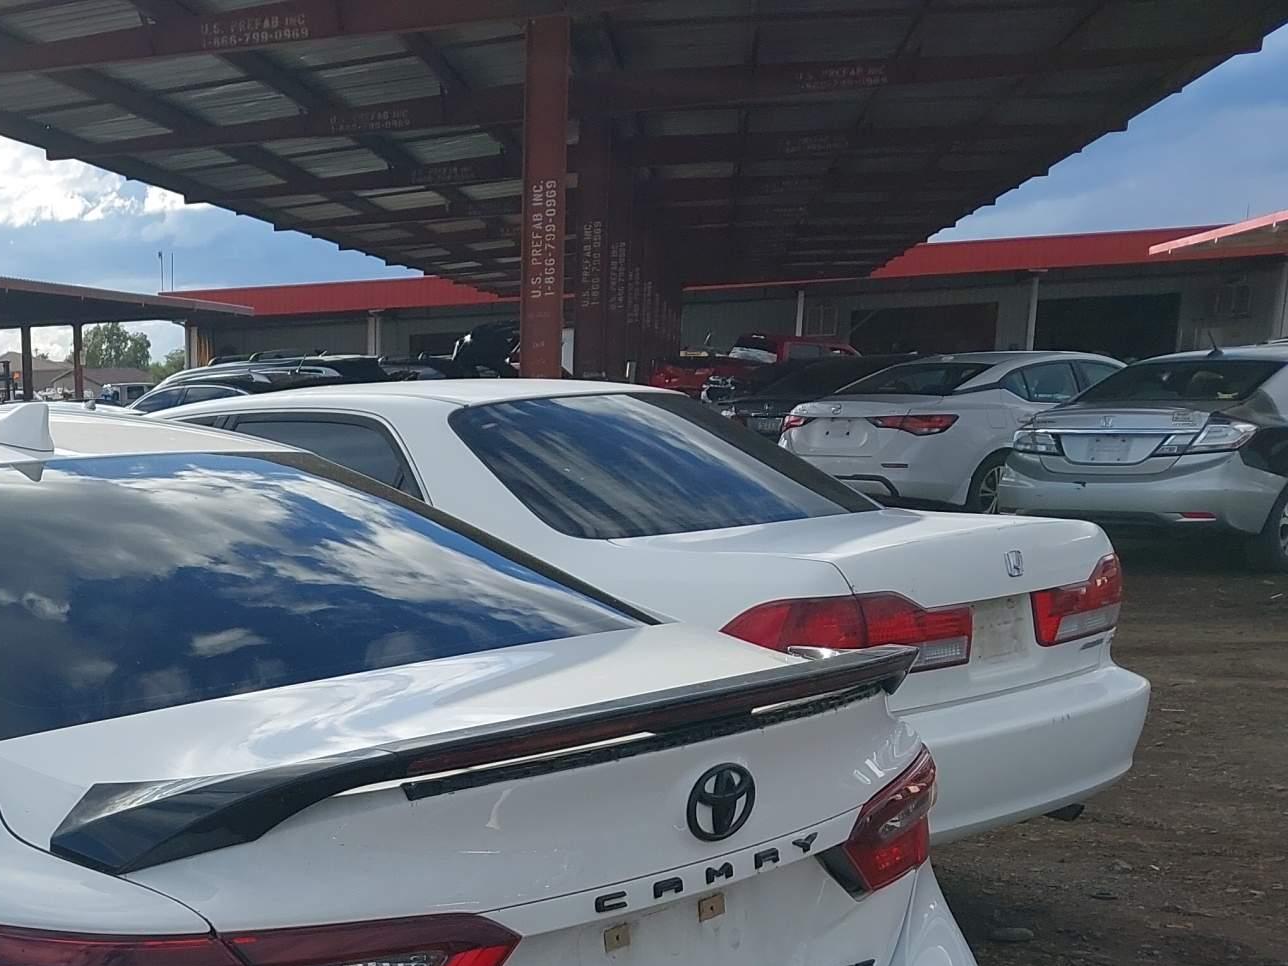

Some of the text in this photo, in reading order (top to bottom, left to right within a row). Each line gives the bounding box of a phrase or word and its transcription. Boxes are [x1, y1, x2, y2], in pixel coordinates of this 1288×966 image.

[530, 179, 545, 298] U.S. PREFAB INC.
[544, 180, 557, 296] 1-866-799-0969
[595, 832, 818, 913] CAMRY
